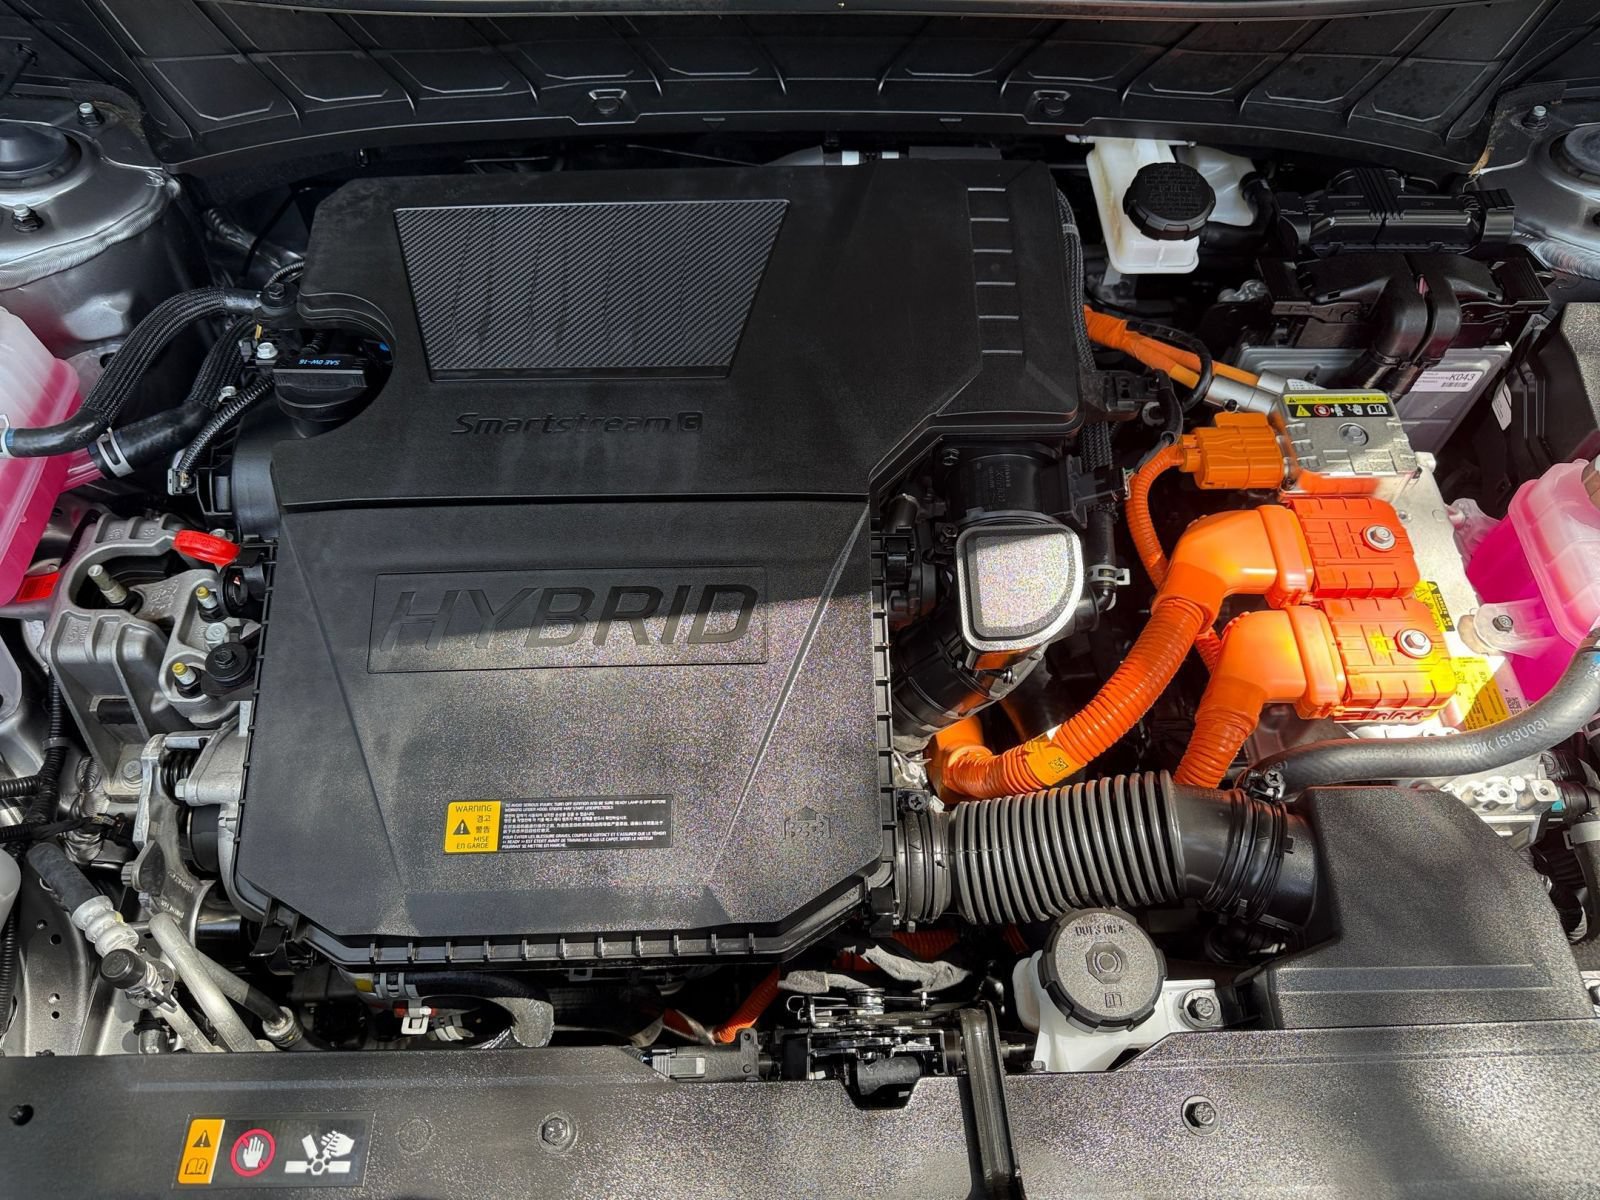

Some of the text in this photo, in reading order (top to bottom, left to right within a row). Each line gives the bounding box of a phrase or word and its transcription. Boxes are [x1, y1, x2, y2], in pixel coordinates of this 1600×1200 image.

[451, 412, 672, 434] Smartstream
[380, 584, 759, 652] HYBRID
[1496, 718, 1550, 749] (513U03)
